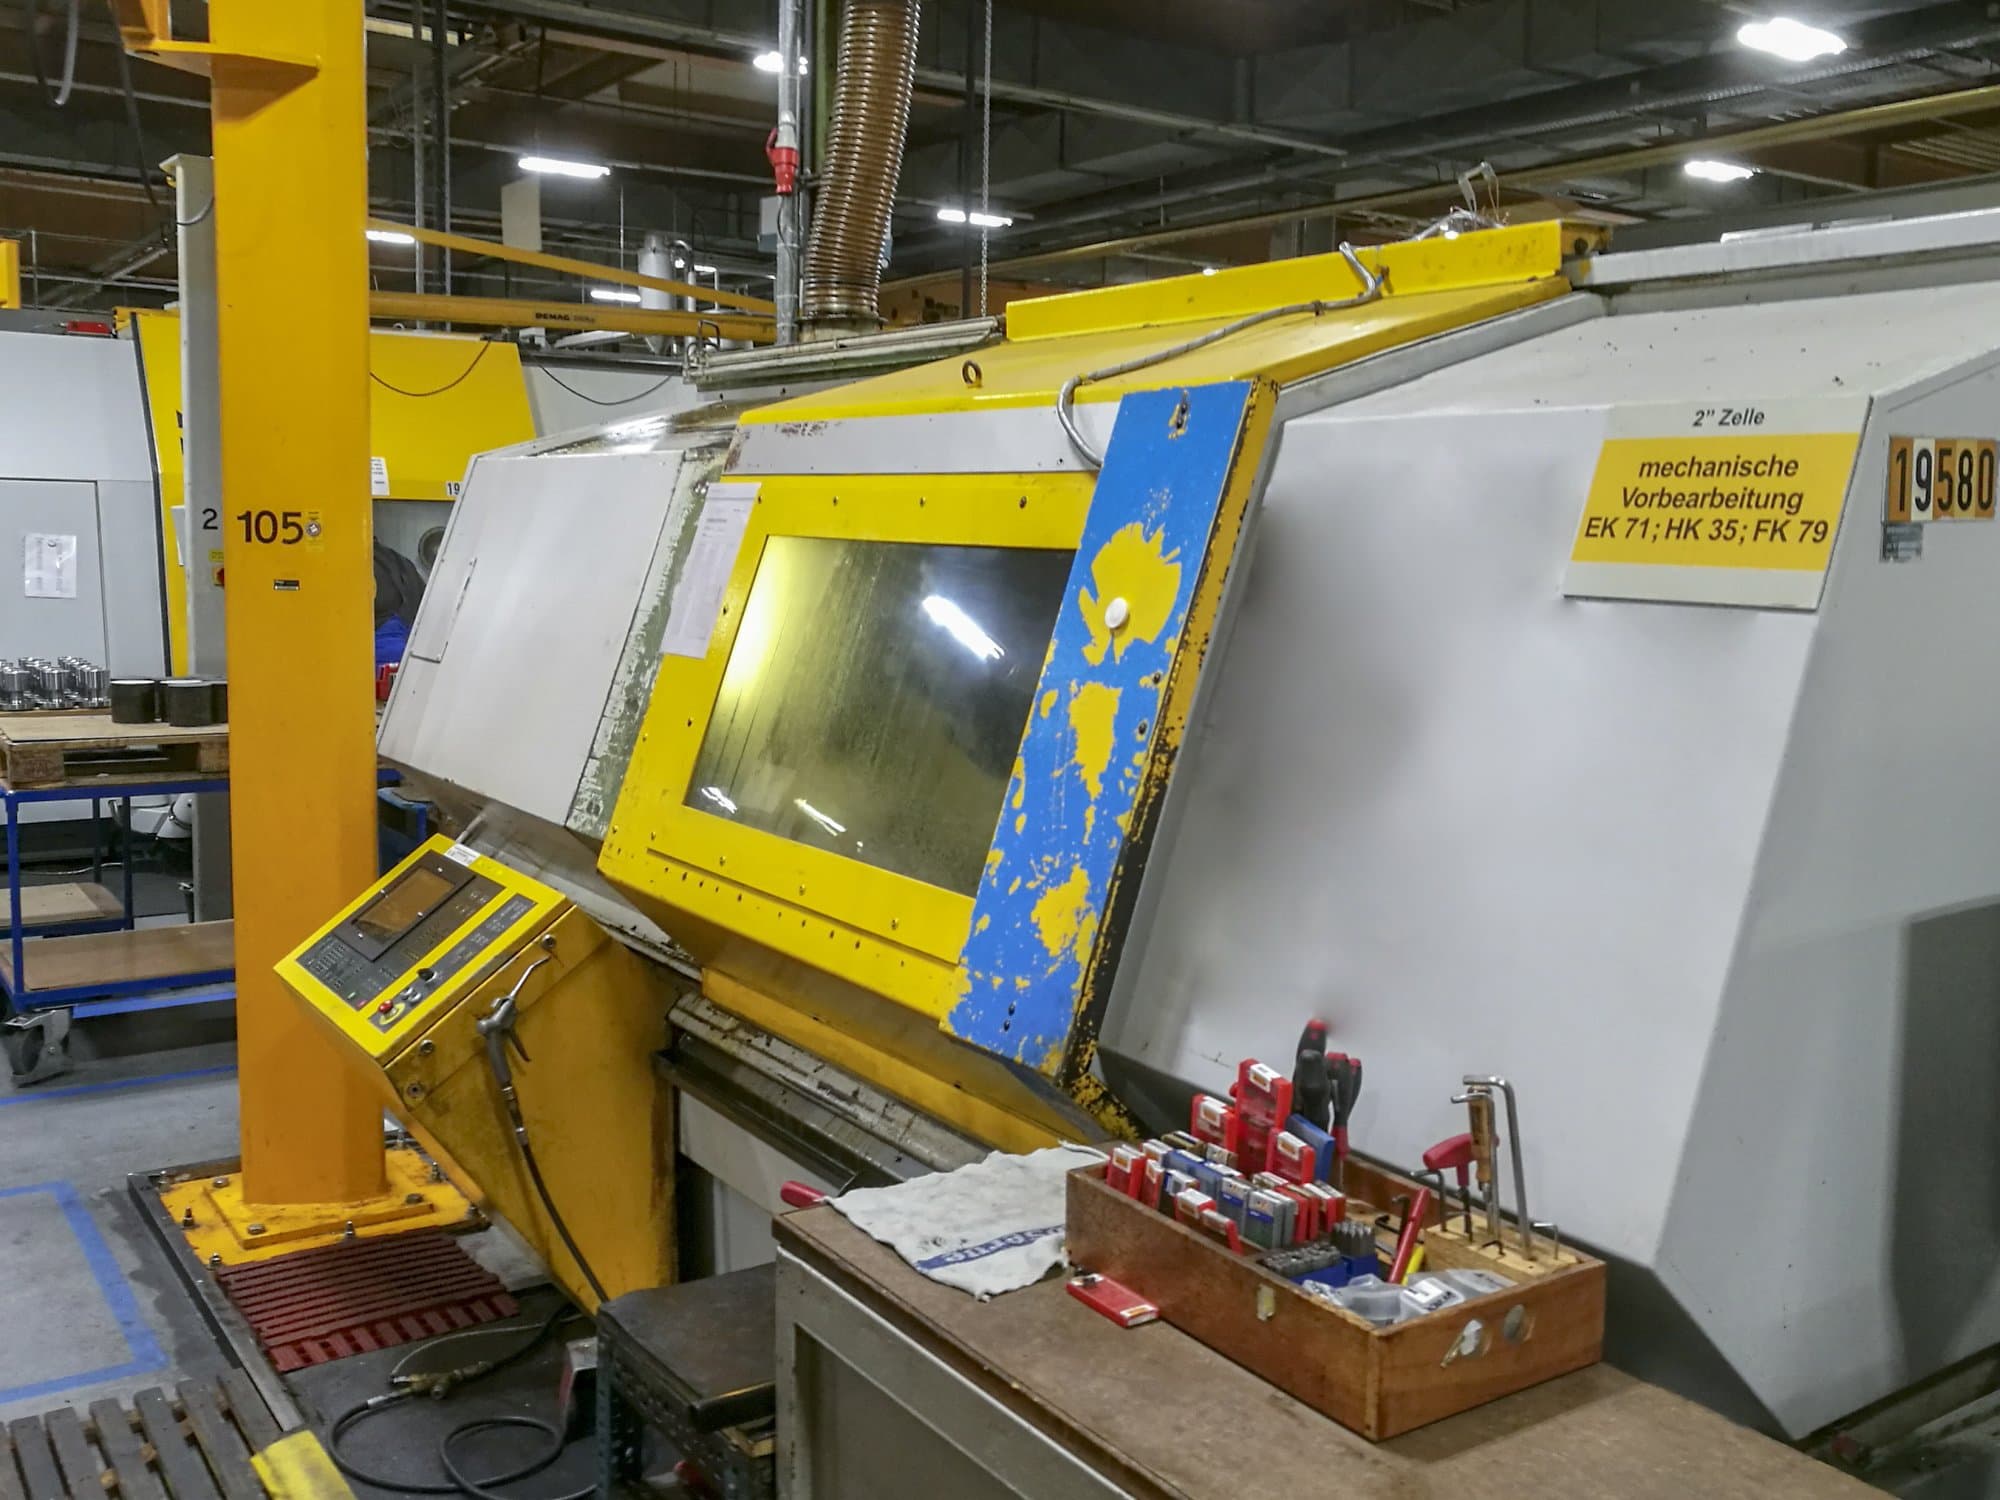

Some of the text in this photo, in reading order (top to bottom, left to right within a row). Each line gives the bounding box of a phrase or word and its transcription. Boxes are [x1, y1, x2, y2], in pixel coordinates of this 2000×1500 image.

[535, 312, 570, 321] DEMAG
[1718, 408, 1765, 427] Zelle
[1638, 454, 1799, 478] mechanische
[1896, 447, 1994, 512] 19580
[1622, 487, 1804, 515] Vorbearbeitung
[237, 510, 304, 545] 105
[1584, 517, 1829, 546] EK 71; HK 35; FK 79
